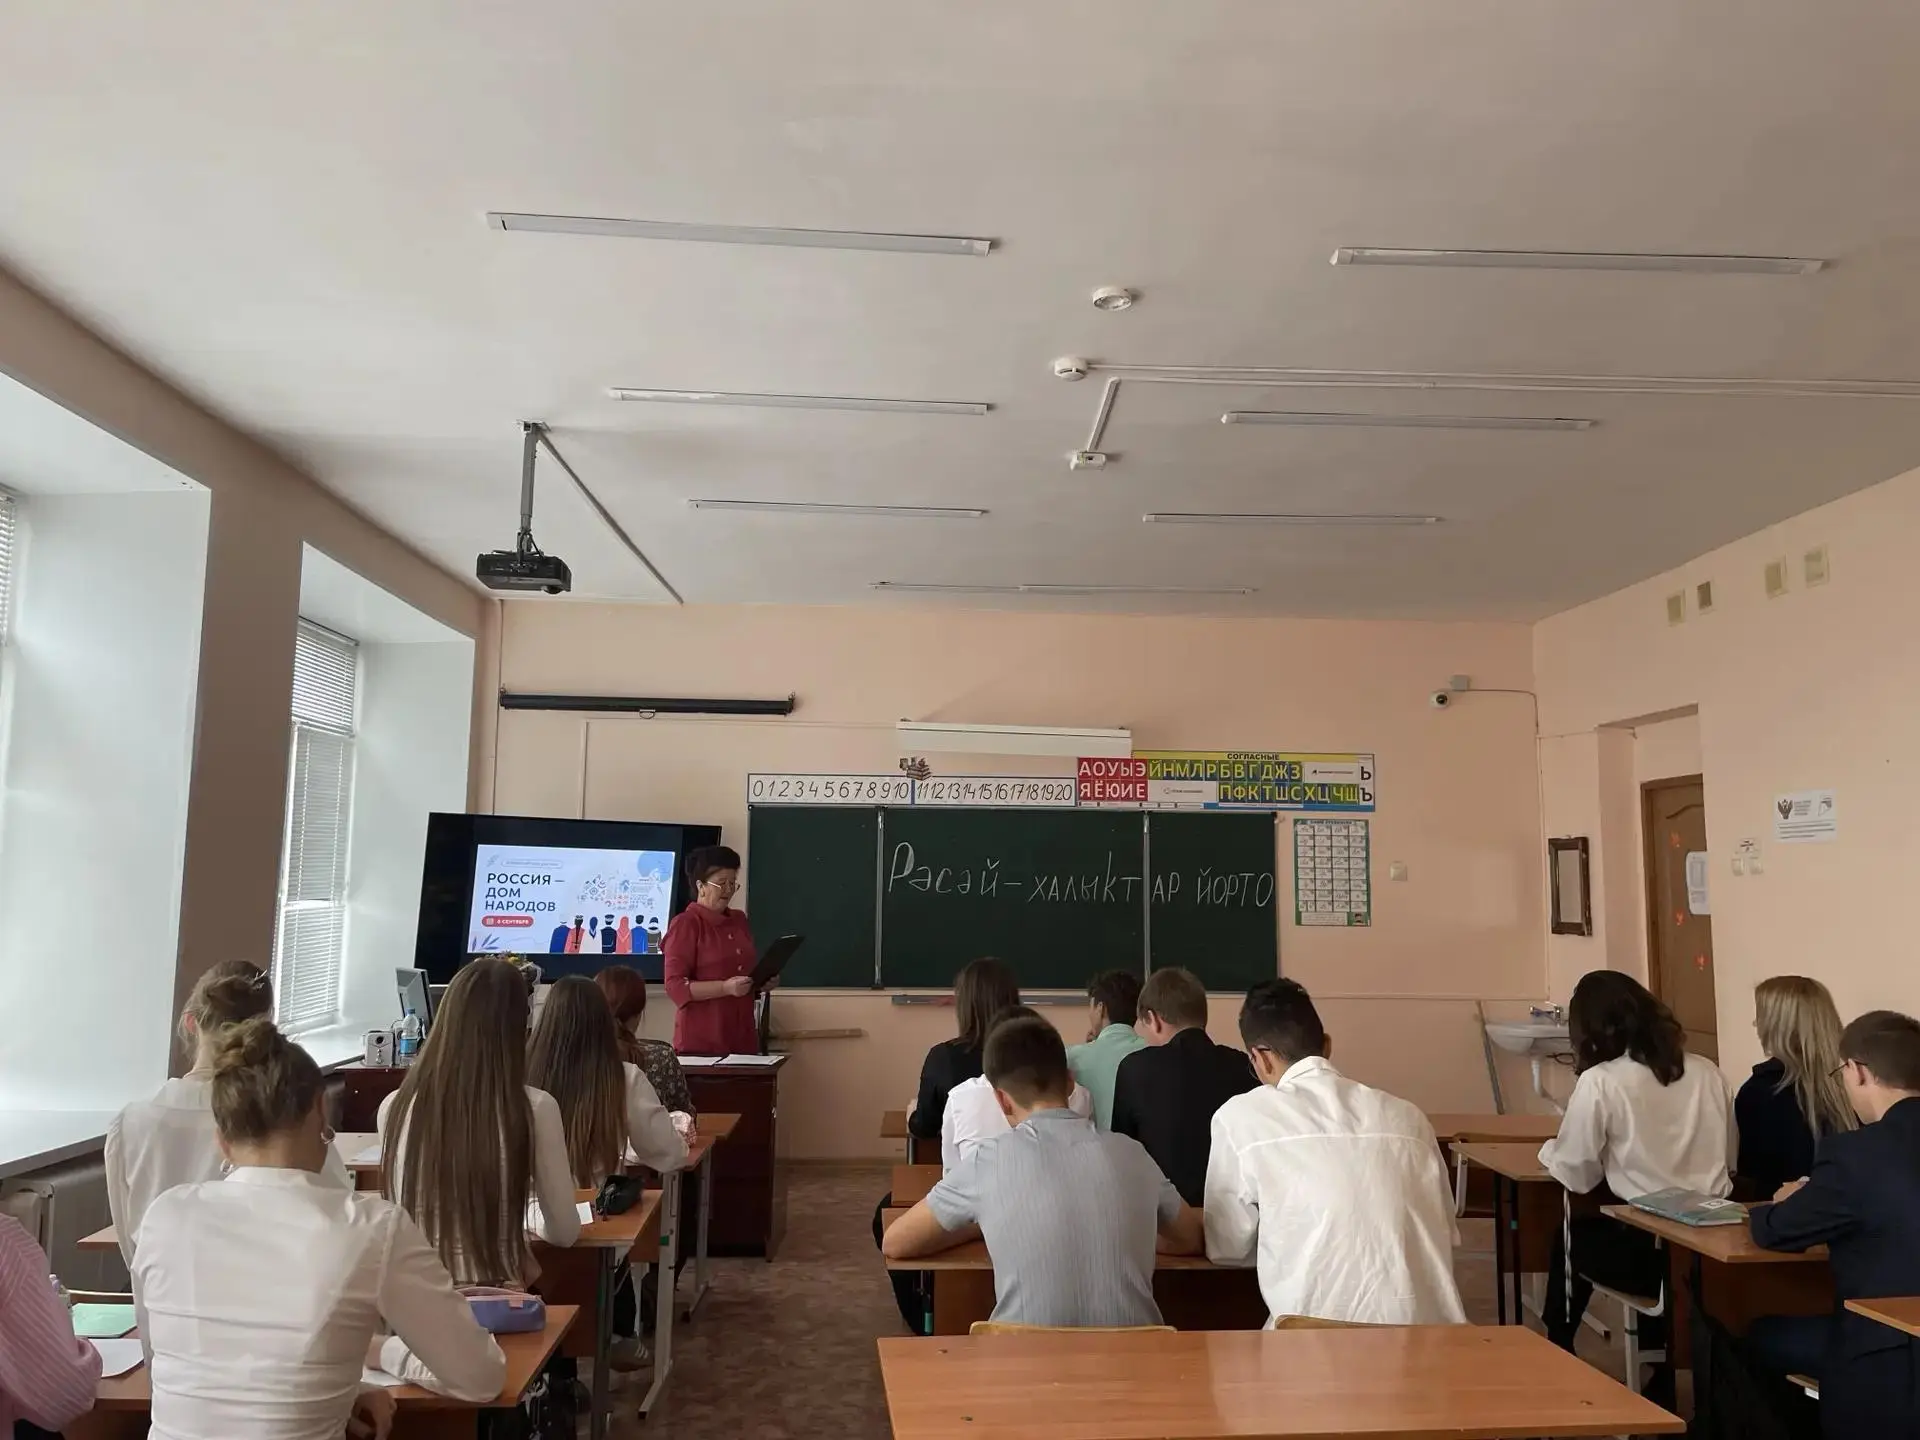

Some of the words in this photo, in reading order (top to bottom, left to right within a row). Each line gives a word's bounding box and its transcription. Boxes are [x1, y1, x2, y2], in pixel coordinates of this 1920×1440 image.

[1226, 753, 1280, 761] СОГЛАСНЫЕ
[487, 872, 552, 886] РОССИЯ
[485, 887, 521, 899] ДОМ
[484, 900, 556, 913] НАРОДОВ
